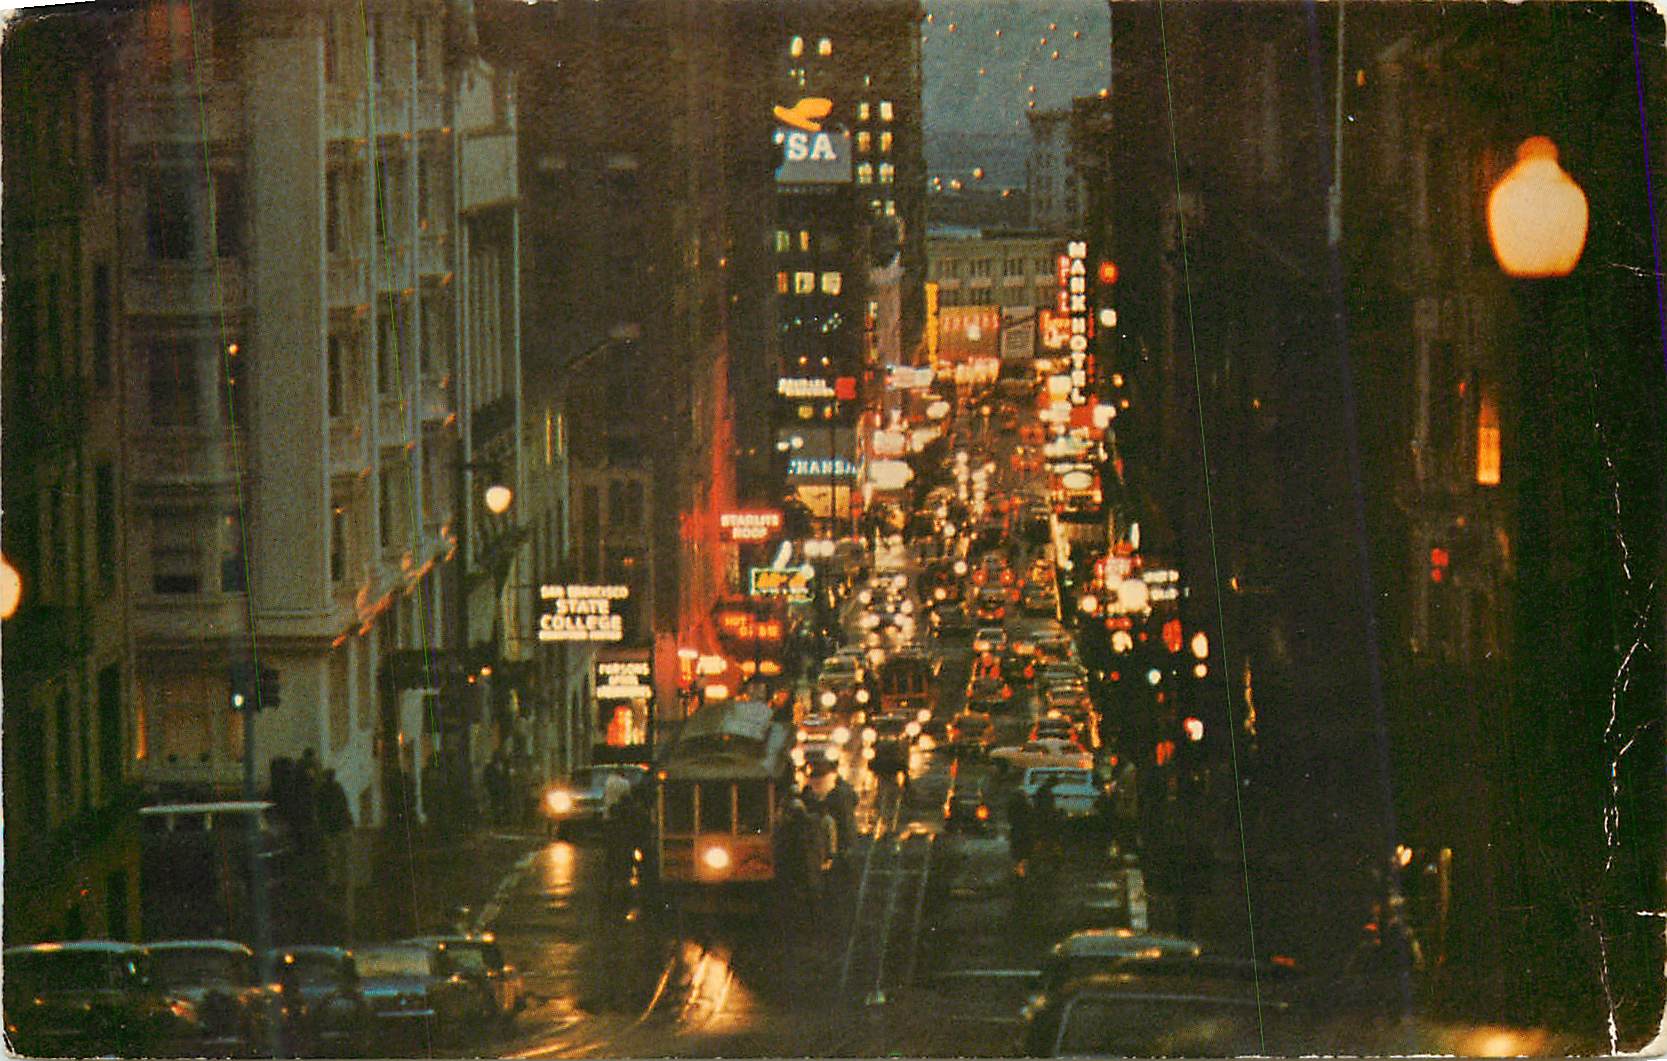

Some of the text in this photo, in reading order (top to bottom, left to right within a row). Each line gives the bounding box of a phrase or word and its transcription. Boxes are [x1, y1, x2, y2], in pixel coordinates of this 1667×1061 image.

[1069, 317, 1088, 406] HOTEL
[541, 584, 565, 600] SAN
[556, 599, 610, 615] STATE
[540, 614, 622, 631] COLLEGE
